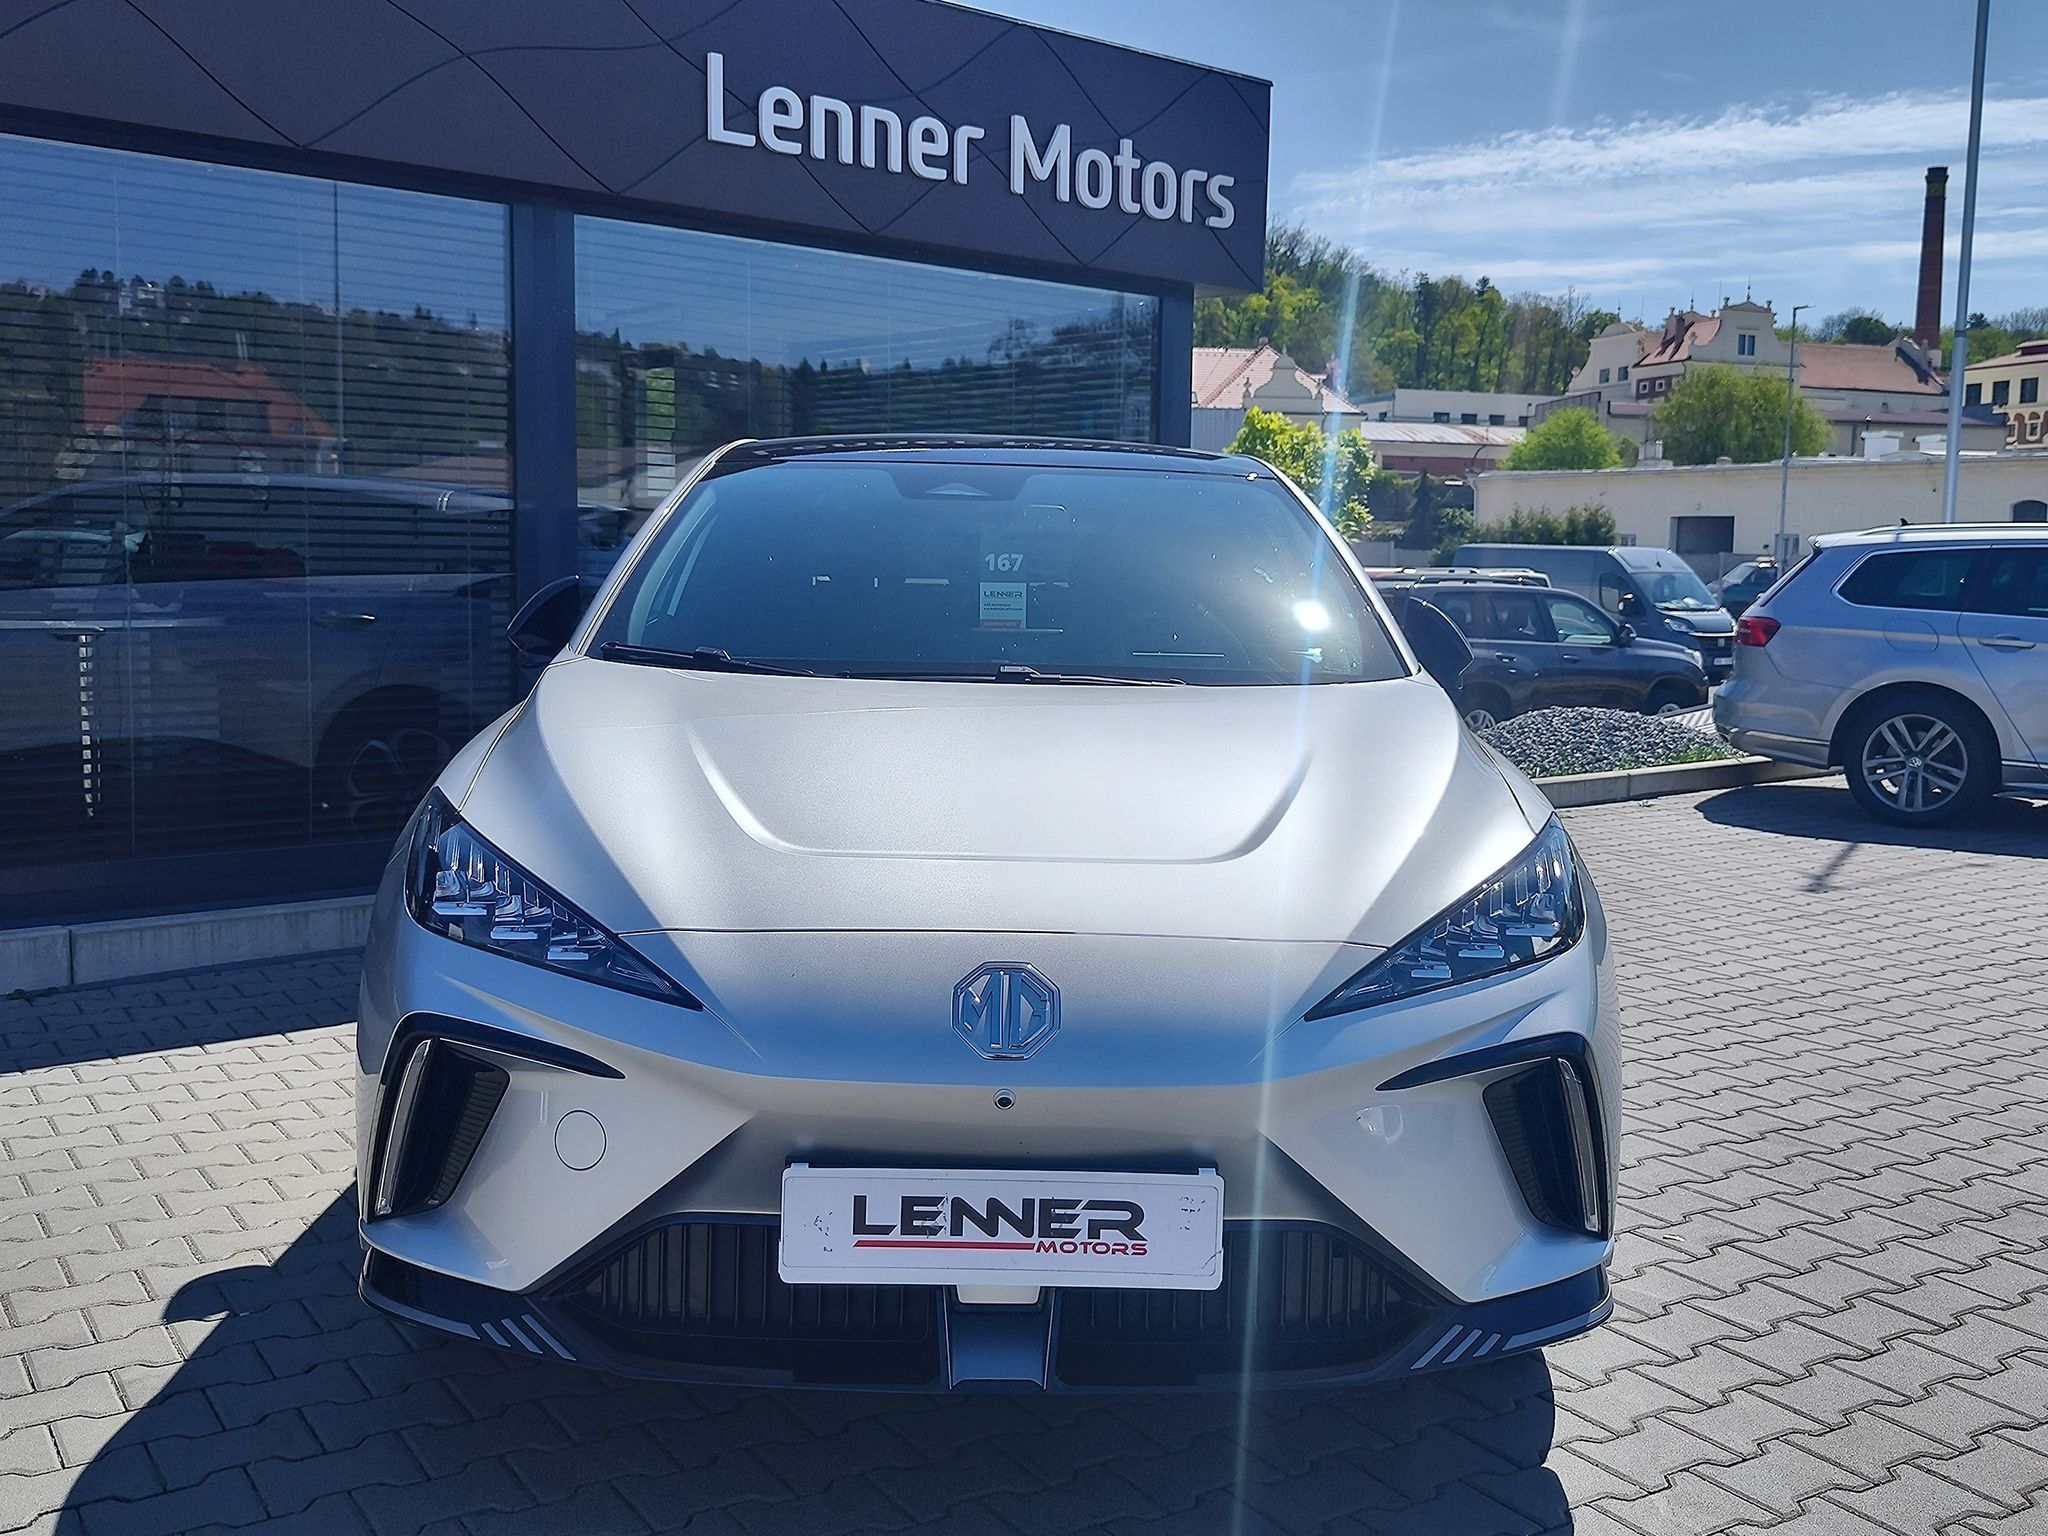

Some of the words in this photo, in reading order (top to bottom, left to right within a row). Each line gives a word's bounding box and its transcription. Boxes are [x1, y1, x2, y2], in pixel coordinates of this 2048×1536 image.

[706, 51, 985, 184] Lenner
[1010, 114, 1235, 229] Motors
[984, 553, 1024, 572] 167
[983, 590, 1023, 599] LENNER
[955, 967, 1053, 1054] MG
[852, 1195, 1146, 1241] LENNER
[1035, 1240, 1148, 1256] MOTORS
